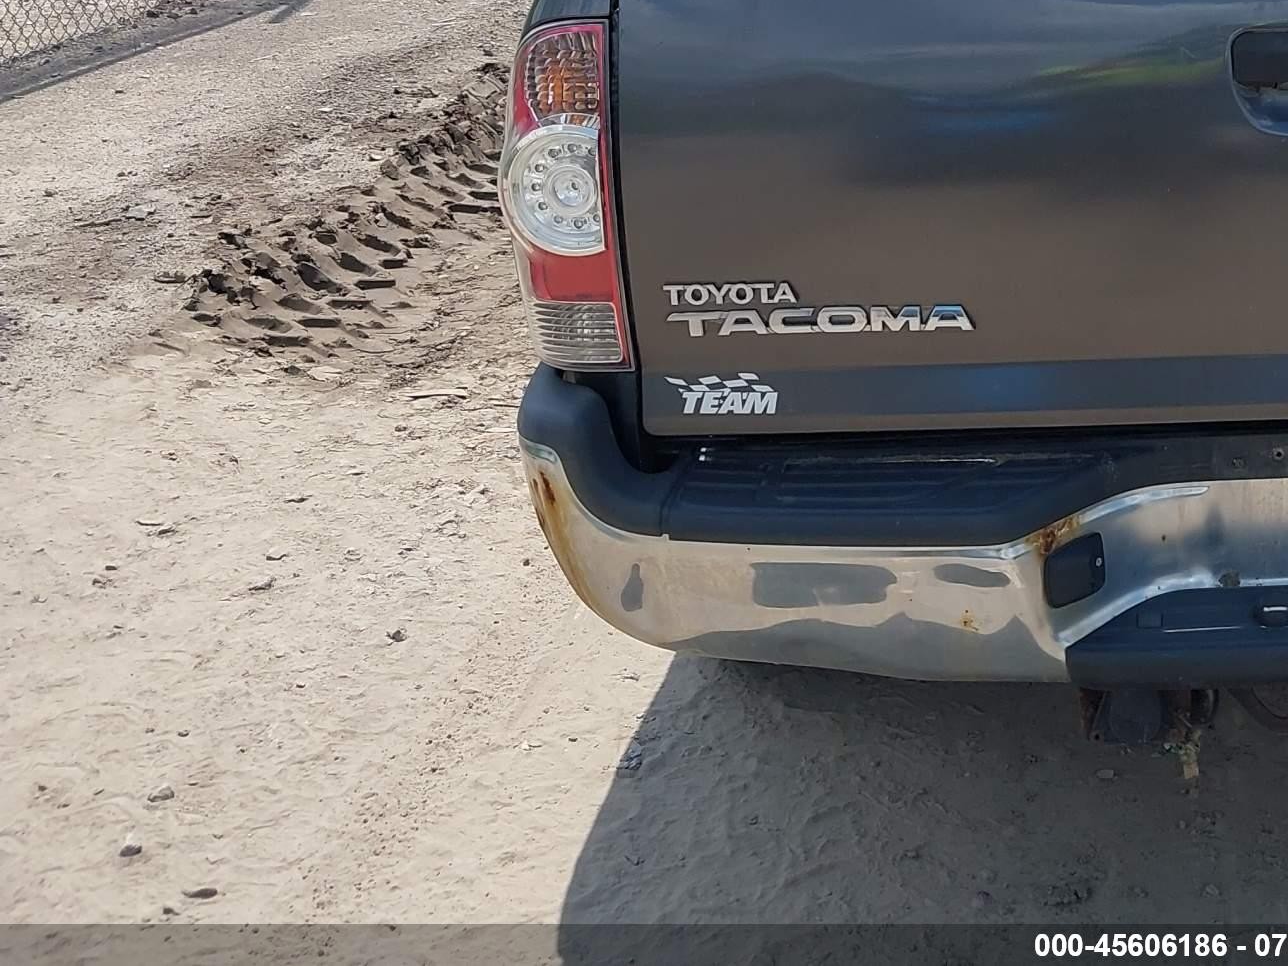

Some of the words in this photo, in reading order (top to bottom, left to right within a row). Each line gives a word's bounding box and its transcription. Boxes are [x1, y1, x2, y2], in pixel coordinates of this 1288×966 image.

[663, 282, 798, 306] TOYOTA
[665, 305, 976, 337] TACOMA
[681, 390, 778, 415] TEAM
